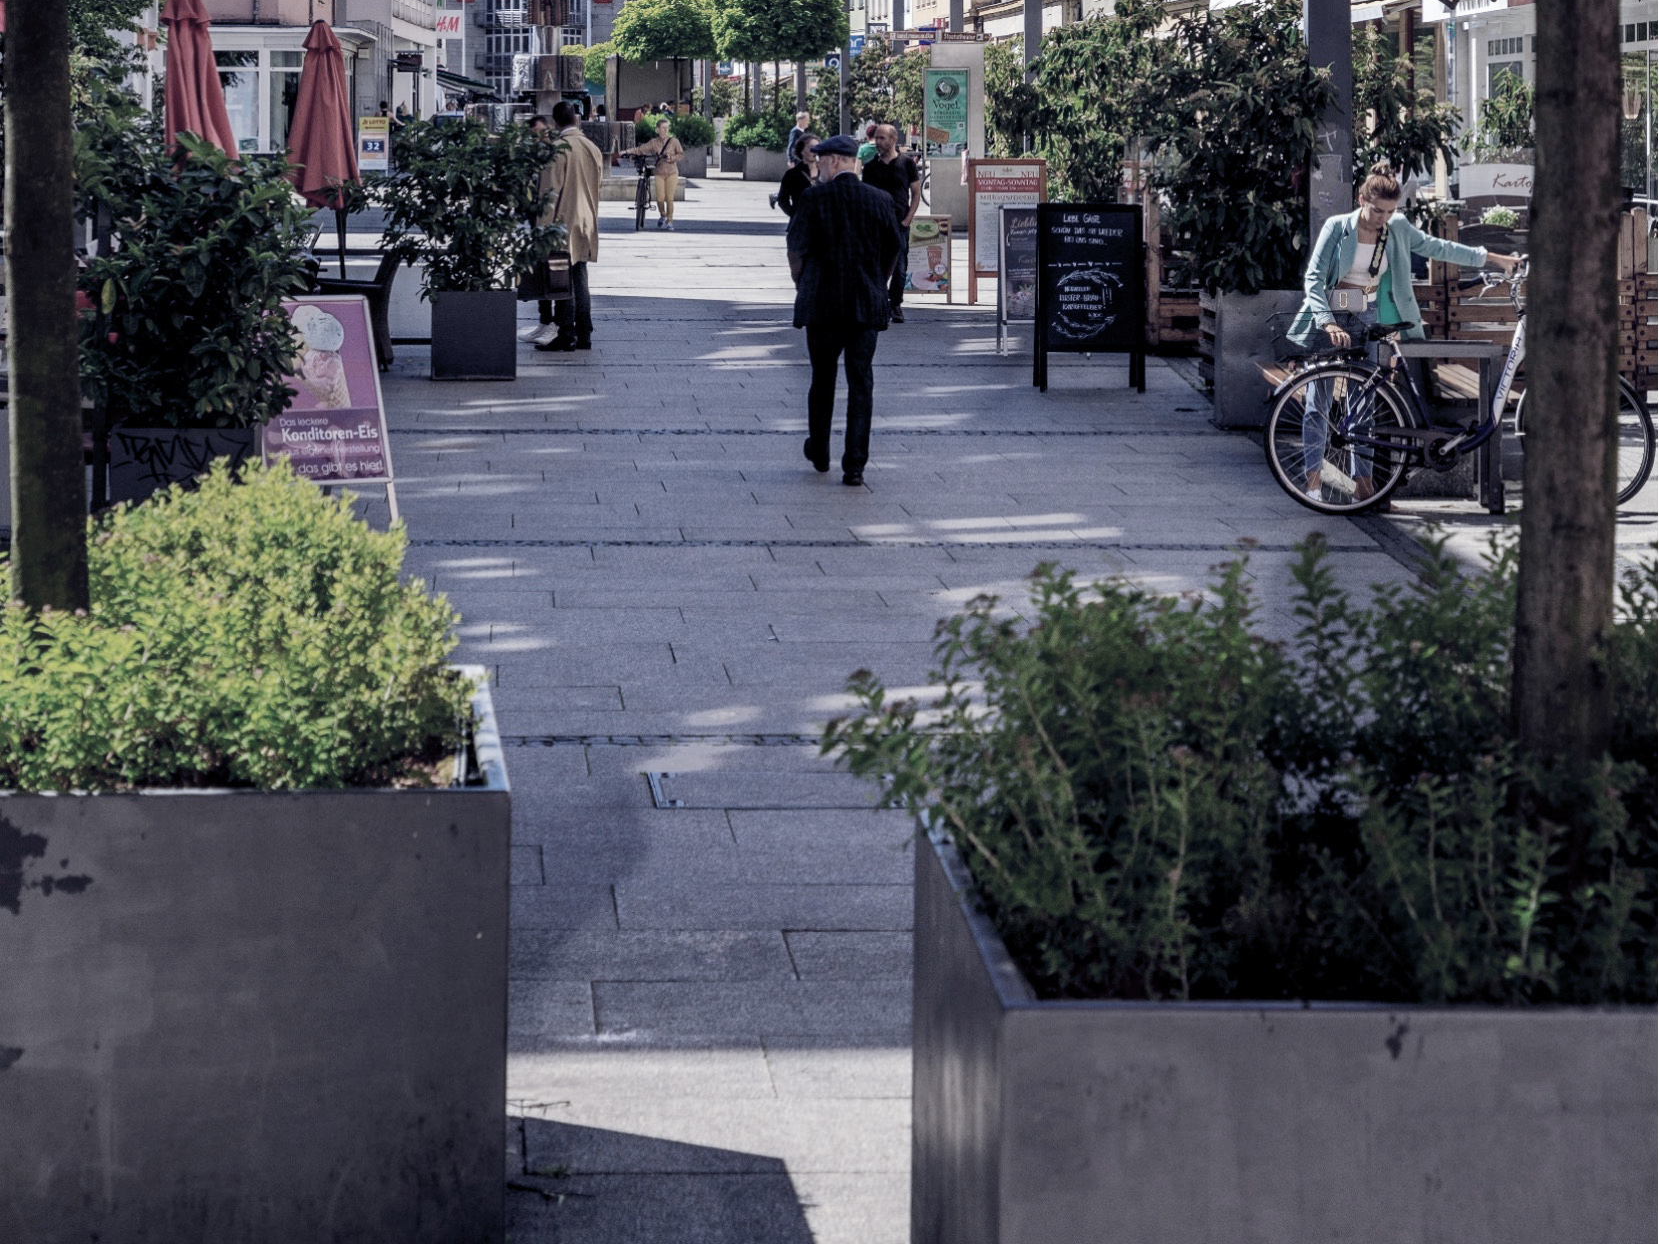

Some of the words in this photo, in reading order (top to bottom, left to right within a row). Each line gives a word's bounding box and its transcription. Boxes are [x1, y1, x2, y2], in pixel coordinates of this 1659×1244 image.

[366, 141, 380, 151] 32
[978, 170, 996, 178] NEU
[1021, 170, 1040, 178] NEU
[1492, 173, 1533, 194] Karto
[1496, 336, 1522, 400] VICTORIA
[279, 418, 297, 427] Das
[298, 417, 329, 427] leckere
[281, 424, 378, 443] Konditoren-Eis
[298, 462, 319, 474] das
[321, 462, 343, 475] gibt
[345, 463, 357, 472] es
[360, 459, 384, 471] hier!
